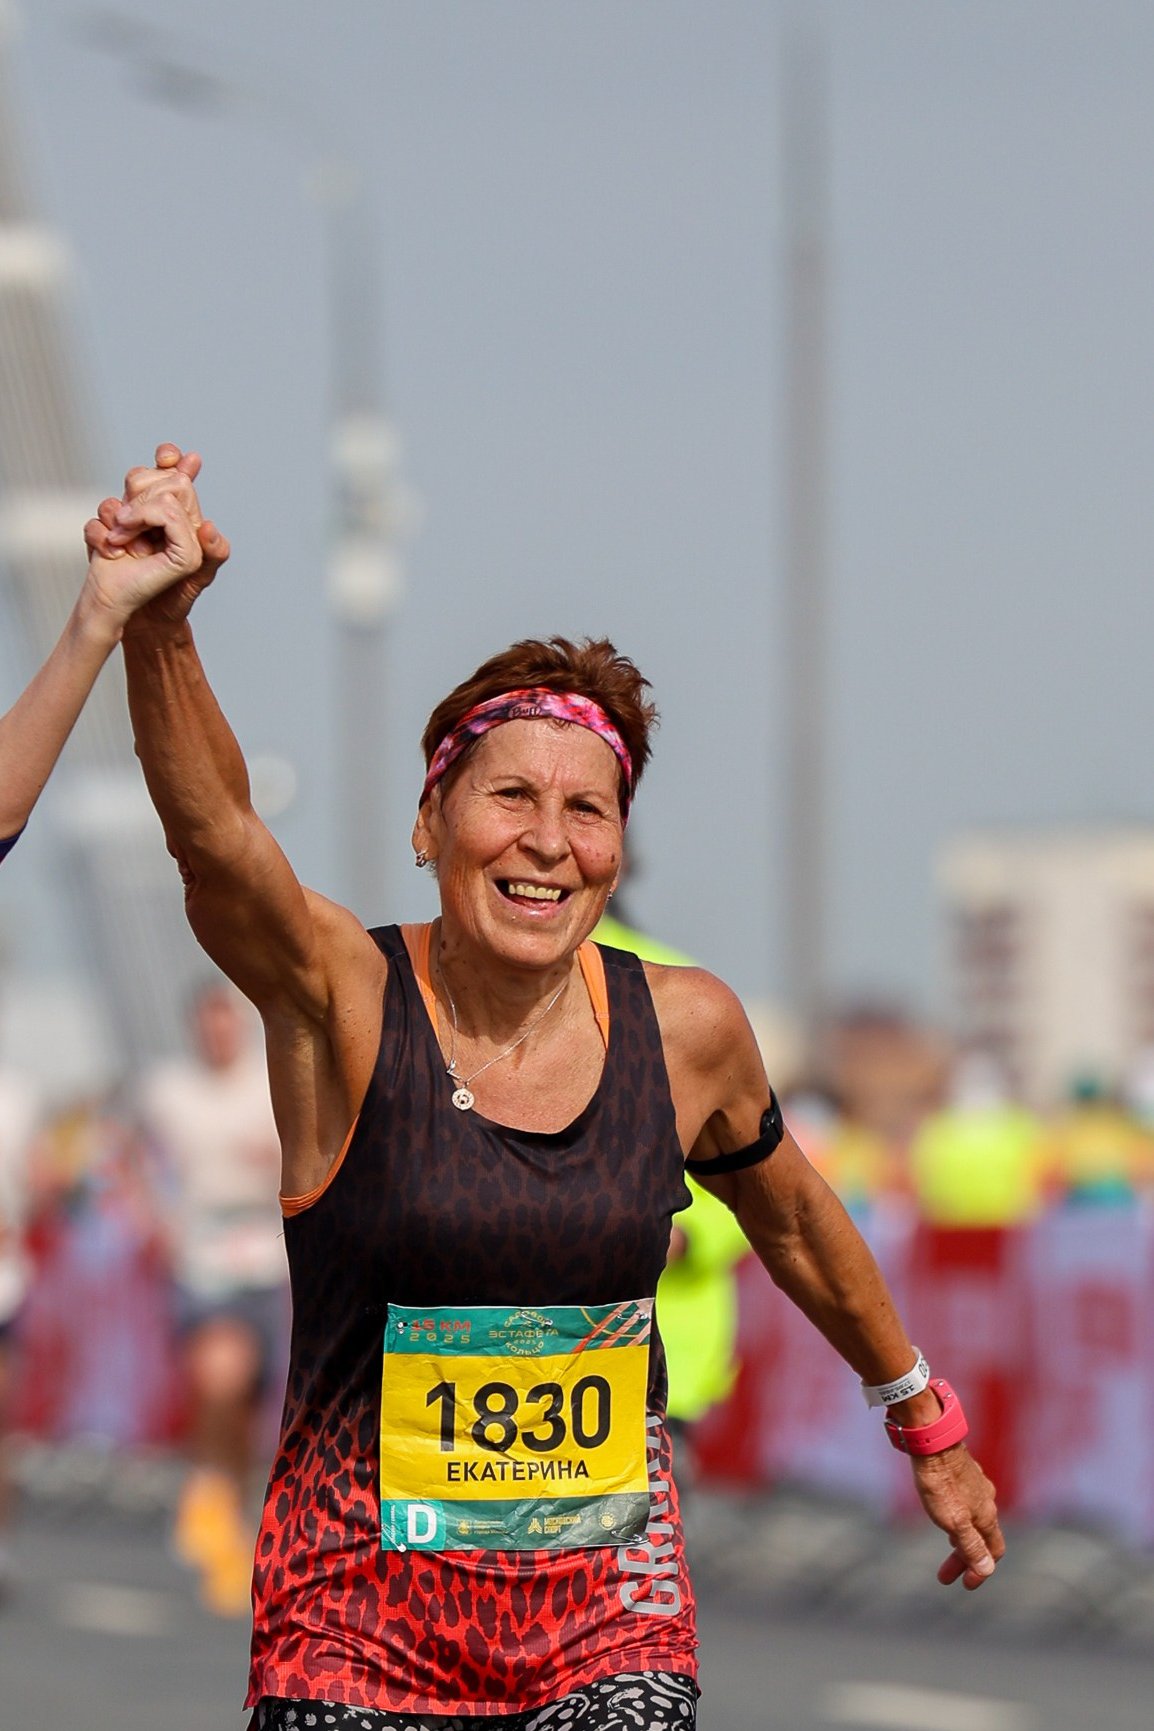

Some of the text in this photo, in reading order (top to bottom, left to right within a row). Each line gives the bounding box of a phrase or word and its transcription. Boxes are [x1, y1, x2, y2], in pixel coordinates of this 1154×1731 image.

[410, 1318, 435, 1331] 15
[409, 1332, 471, 1344] 2025
[489, 1328, 559, 1339] ЭСТАФЕТА
[505, 1340, 544, 1355] КОЛЬЦО
[425, 1375, 612, 1454] 1830
[447, 1460, 589, 1482] ЕКАТЕРИНА
[407, 1503, 437, 1544] D
